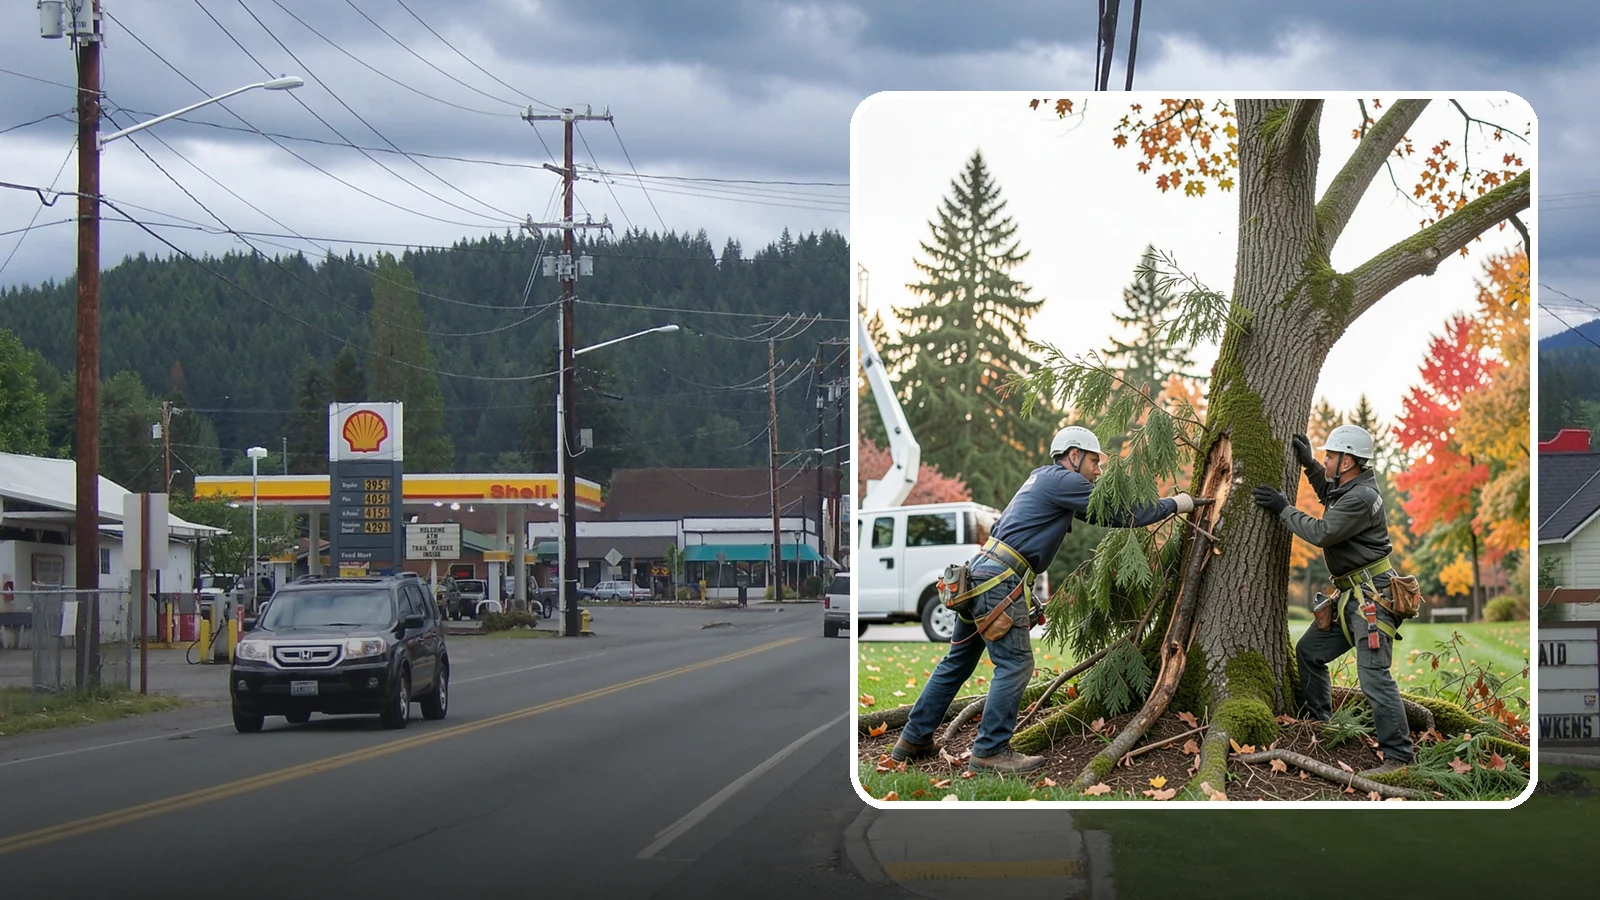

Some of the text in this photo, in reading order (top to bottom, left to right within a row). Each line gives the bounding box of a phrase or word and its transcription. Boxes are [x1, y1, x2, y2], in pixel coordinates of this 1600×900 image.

[366, 480, 384, 490] 395
[490, 484, 547, 498] Shell
[366, 494, 384, 504] 405
[366, 508, 384, 518] 415
[366, 522, 384, 533] 429
